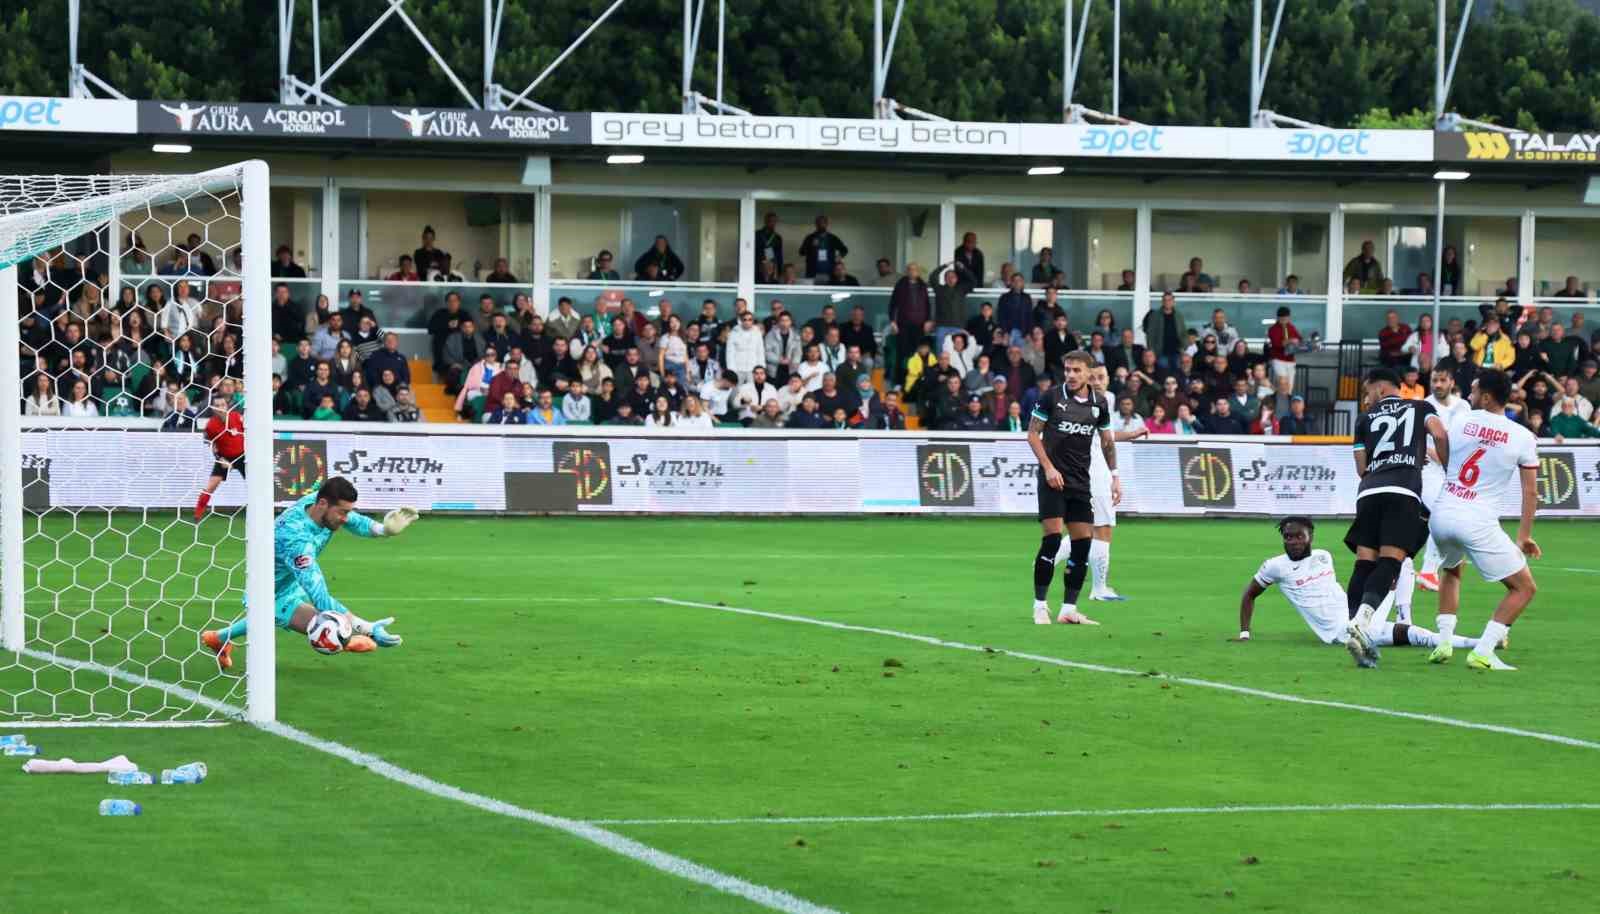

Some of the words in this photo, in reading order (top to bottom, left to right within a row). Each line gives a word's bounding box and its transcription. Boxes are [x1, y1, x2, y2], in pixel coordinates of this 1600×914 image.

[210, 106, 238, 116] GRUP
[263, 108, 345, 126] ACROPOL
[439, 112, 466, 121] GRUP
[197, 115, 254, 131] AURA
[282, 124, 325, 133] BODRUM
[427, 120, 481, 137] AURA
[490, 114, 569, 132] ACROPOL
[604, 117, 684, 141] grey
[697, 117, 795, 140] beton
[509, 129, 550, 139] BODRUM
[820, 123, 899, 147] grey
[912, 122, 1007, 145] beton
[1510, 133, 1600, 152] TALAY
[1515, 151, 1597, 160] LOGISTICS
[1370, 407, 1415, 459] 21
[1478, 426, 1508, 443] ARCA
[1387, 453, 1415, 465] ASLAN
[1458, 447, 1487, 487] 6
